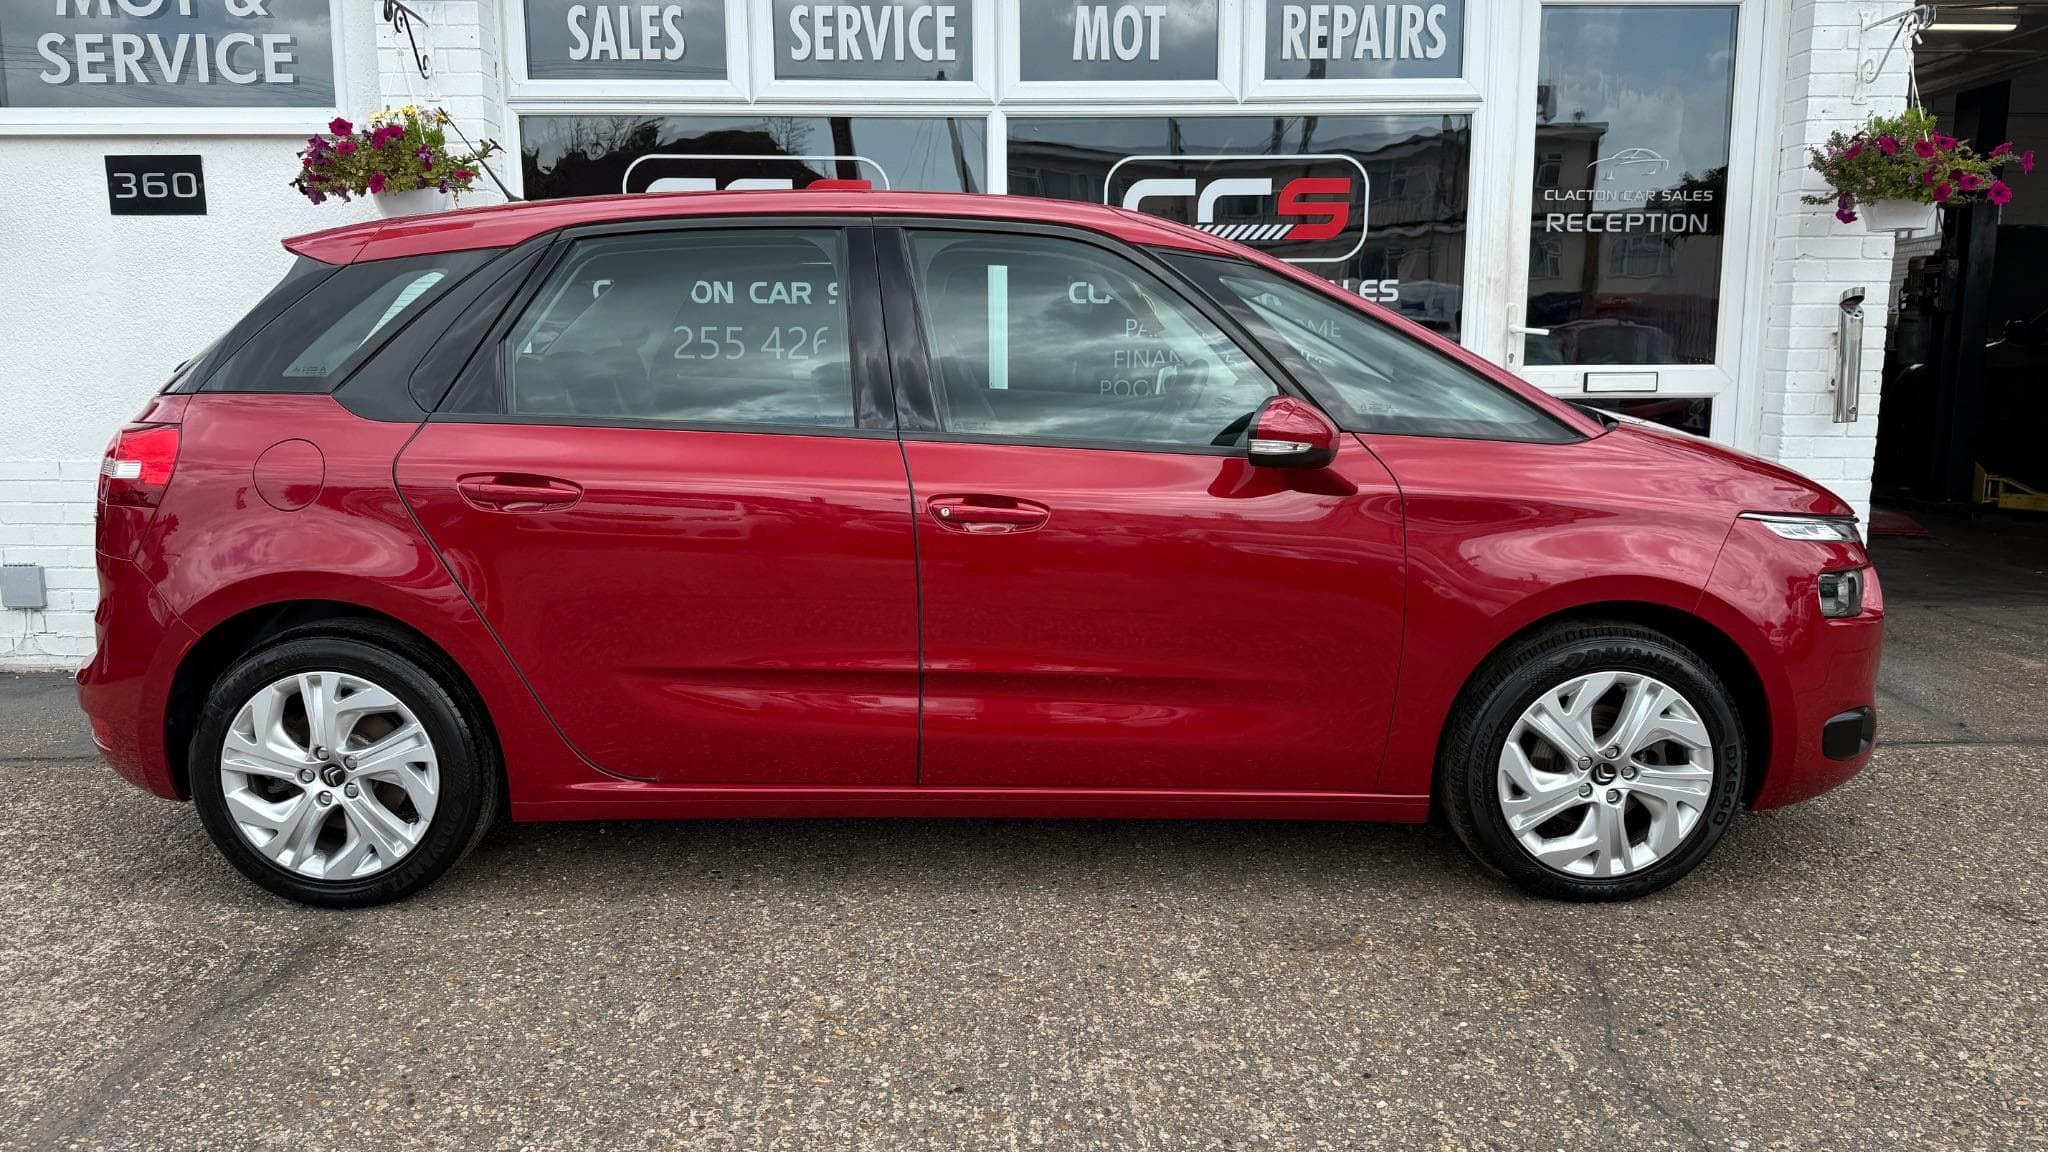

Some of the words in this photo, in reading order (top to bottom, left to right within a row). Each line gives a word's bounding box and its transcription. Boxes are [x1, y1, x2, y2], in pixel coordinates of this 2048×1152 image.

[567, 4, 686, 61] SALES
[789, 4, 957, 62] SERVICE
[1072, 4, 1167, 61] MOT
[1281, 3, 1448, 60] REPAIRS
[36, 32, 295, 85] SERVICE
[113, 172, 198, 199] 360
[1544, 189, 1617, 201] CLACTON
[1623, 189, 1656, 201] CAR
[1661, 190, 1714, 202] SALES
[1545, 212, 1709, 233] RECEPTION
[749, 281, 812, 305] CAR
